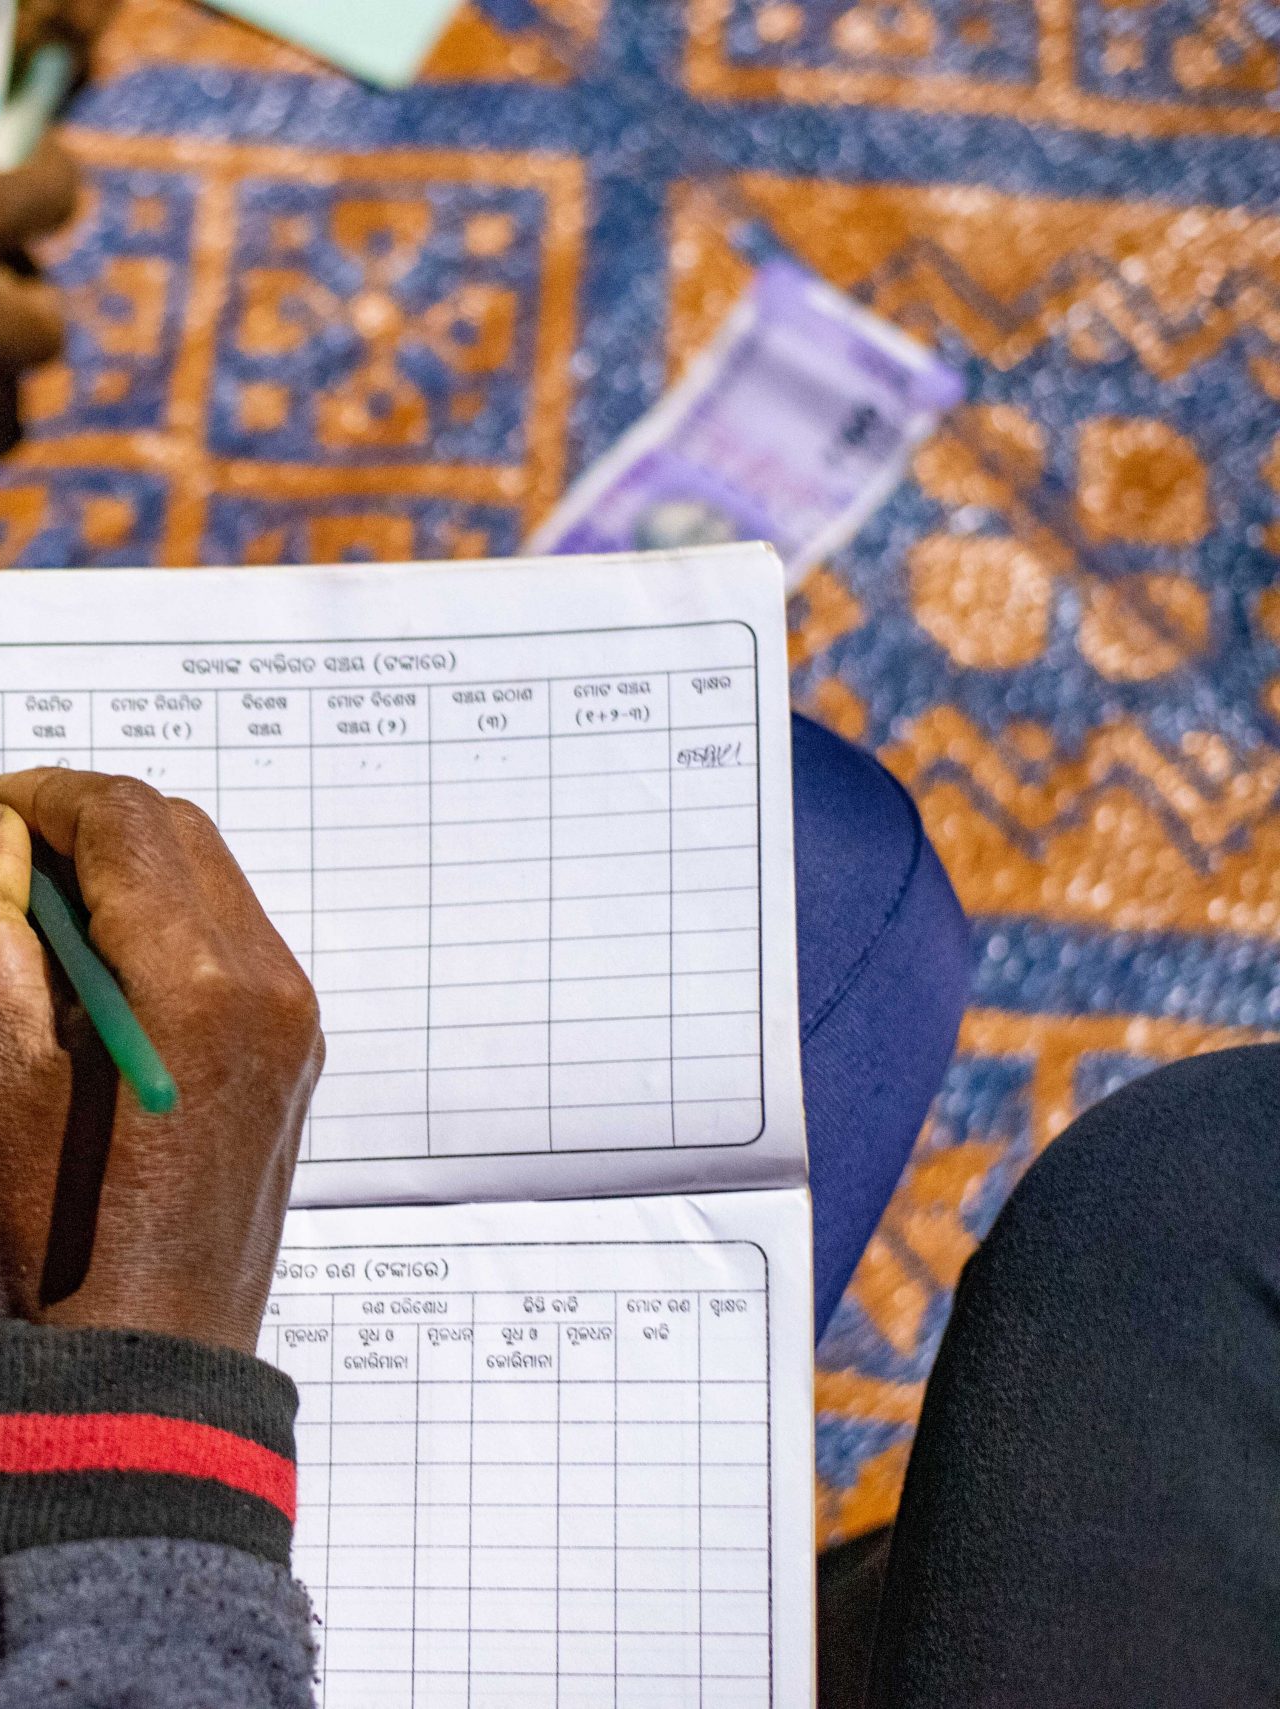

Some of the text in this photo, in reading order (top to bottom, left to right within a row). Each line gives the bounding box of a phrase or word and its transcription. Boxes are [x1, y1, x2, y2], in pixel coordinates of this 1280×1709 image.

[573, 684, 611, 698] ମୋଟ
[111, 697, 149, 712] ମୋଟ
[327, 694, 365, 709] ମୋଟ
[626, 1298, 663, 1314] ମୋଟ
